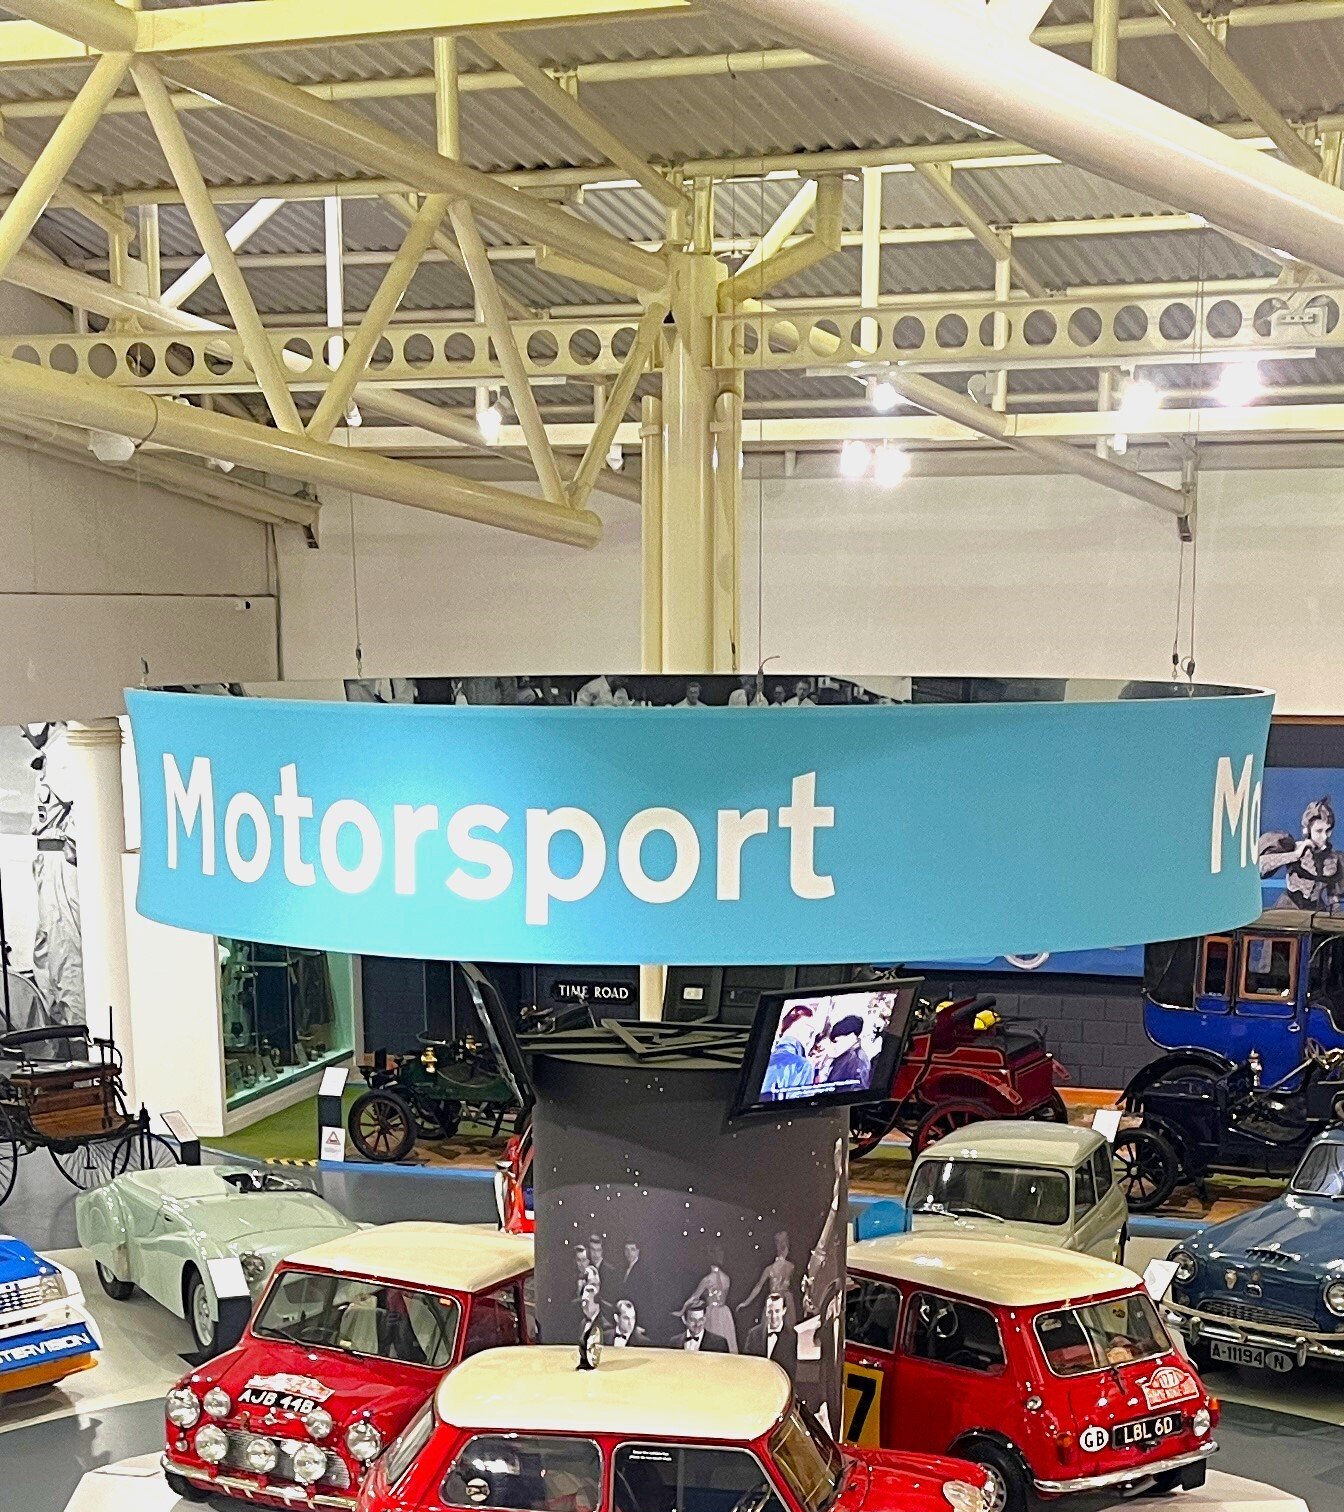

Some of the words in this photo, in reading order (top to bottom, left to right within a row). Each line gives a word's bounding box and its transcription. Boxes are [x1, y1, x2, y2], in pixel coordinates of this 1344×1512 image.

[163, 754, 835, 925] Motorsport
[558, 984, 590, 998] TIME
[594, 985, 629, 999] ROAD
[1211, 1343, 1264, 1366] A-11194
[237, 1388, 278, 1406] AJB
[279, 1396, 315, 1414] 44B
[1084, 1429, 1105, 1449] GB
[1124, 1423, 1151, 1444] LBL
[1154, 1417, 1173, 1437] 6D
